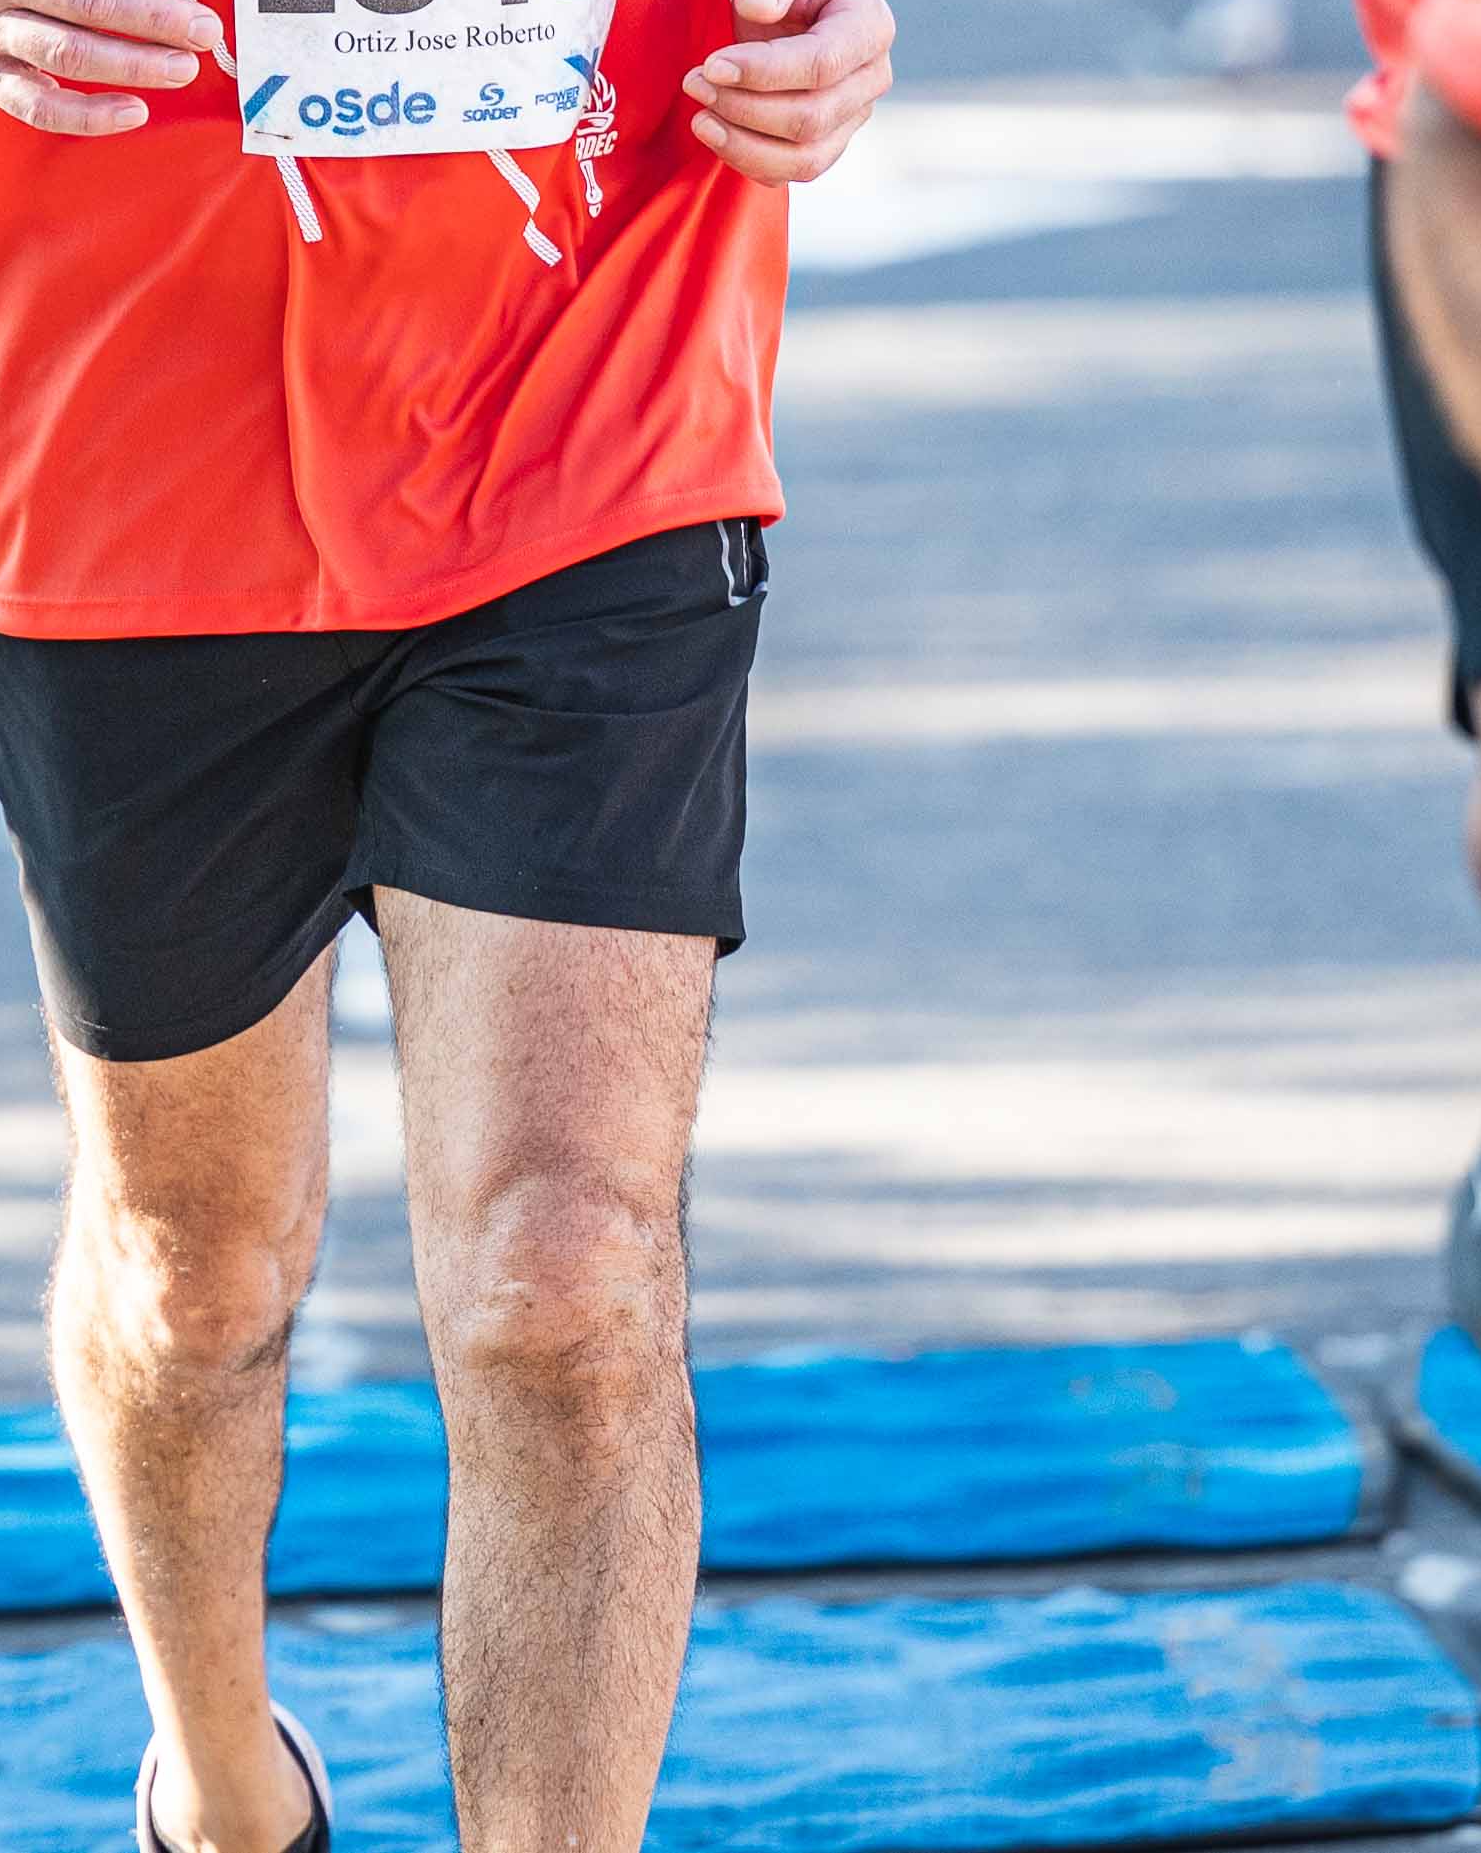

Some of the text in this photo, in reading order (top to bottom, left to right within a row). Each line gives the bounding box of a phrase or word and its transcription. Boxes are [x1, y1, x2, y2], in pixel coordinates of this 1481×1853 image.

[334, 21, 556, 54] Ortiz Jose Roberto
